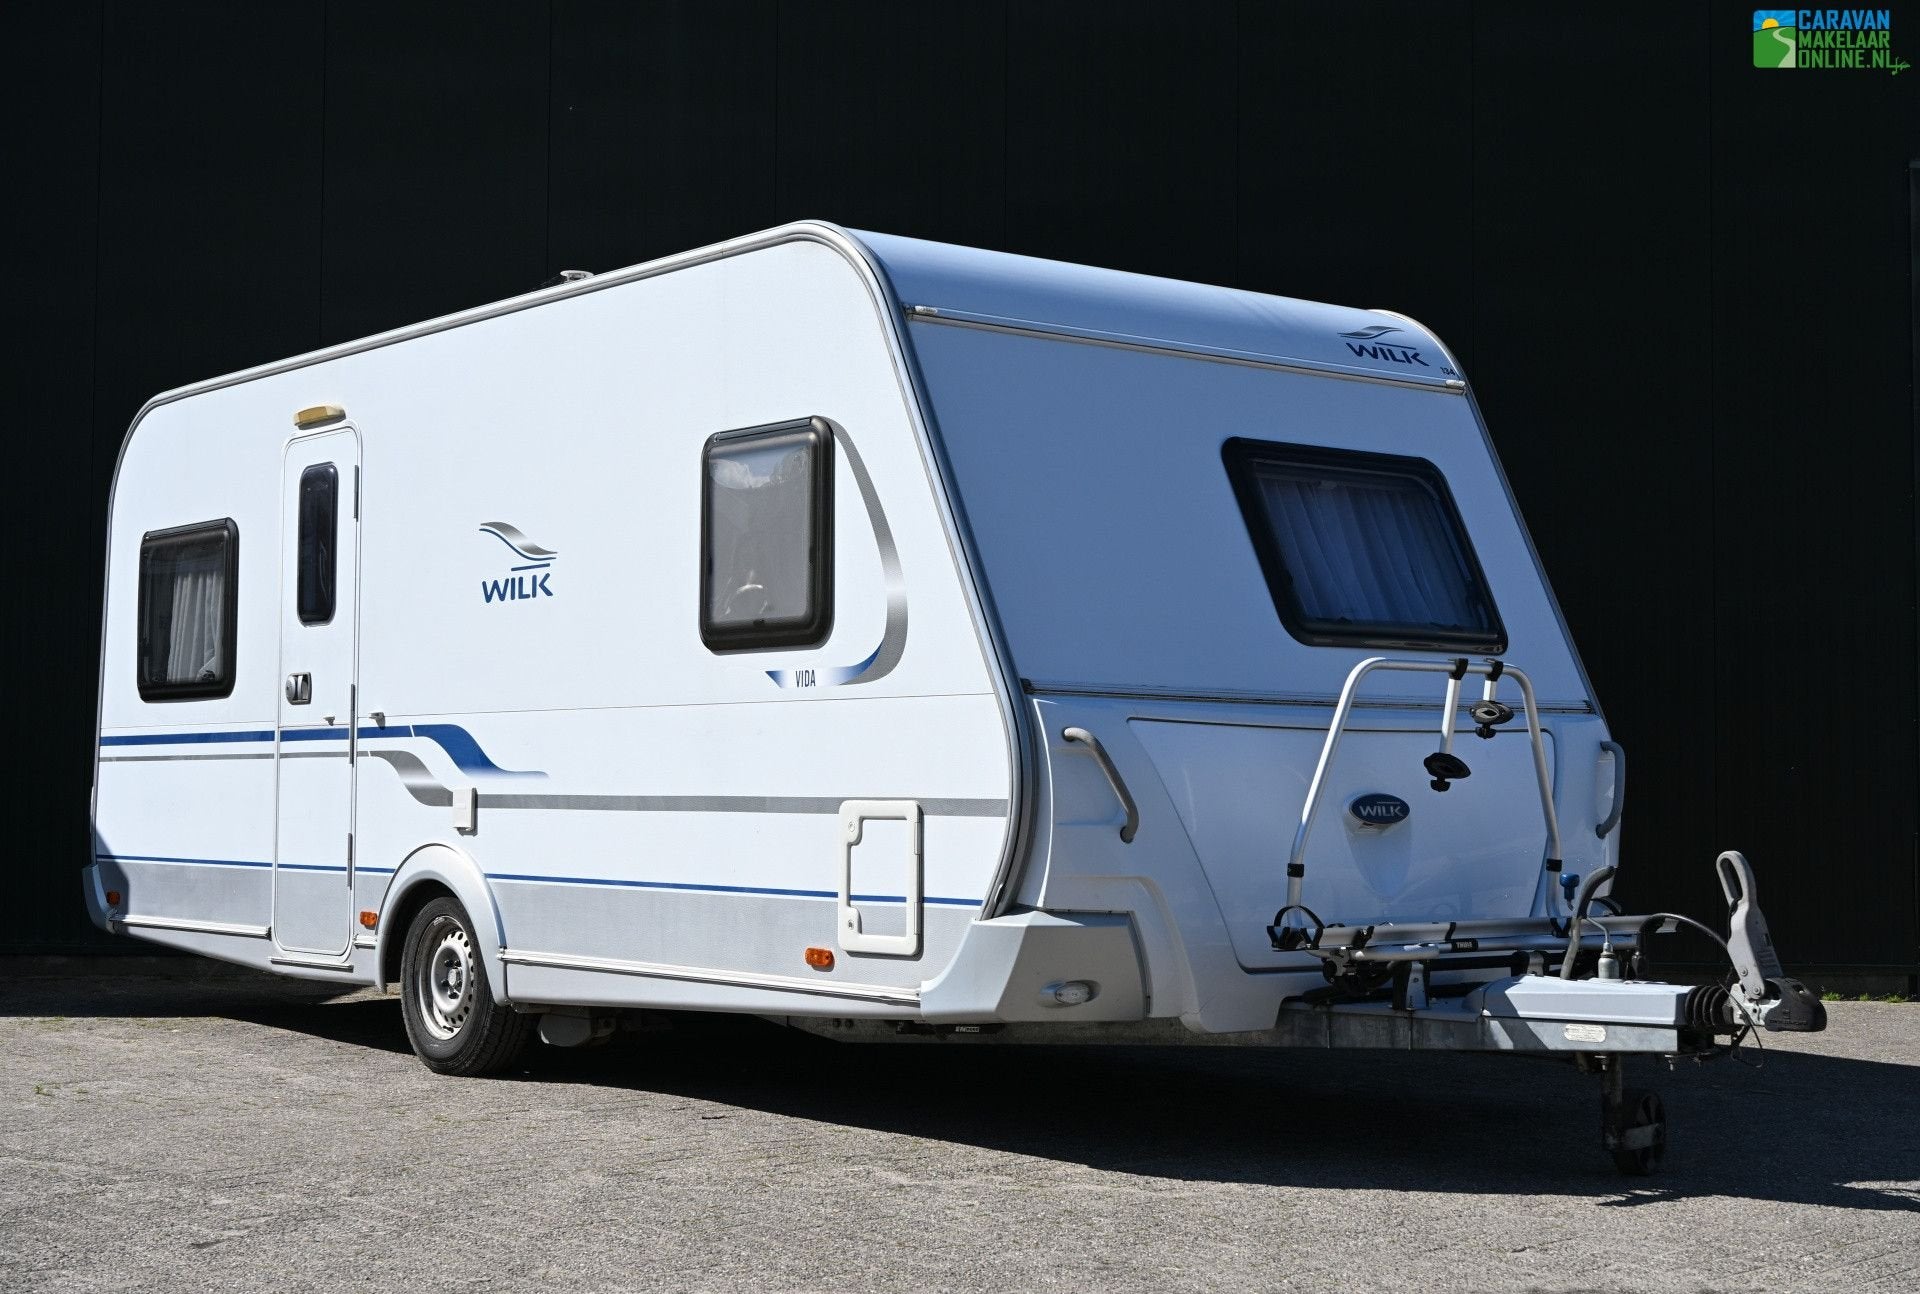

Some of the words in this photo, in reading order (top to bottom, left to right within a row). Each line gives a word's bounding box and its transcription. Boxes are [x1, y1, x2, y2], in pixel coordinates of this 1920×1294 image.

[1346, 342, 1430, 367] WILK
[481, 572, 554, 604] WILK
[795, 669, 816, 688] VIDA
[1359, 805, 1404, 817] WILK
